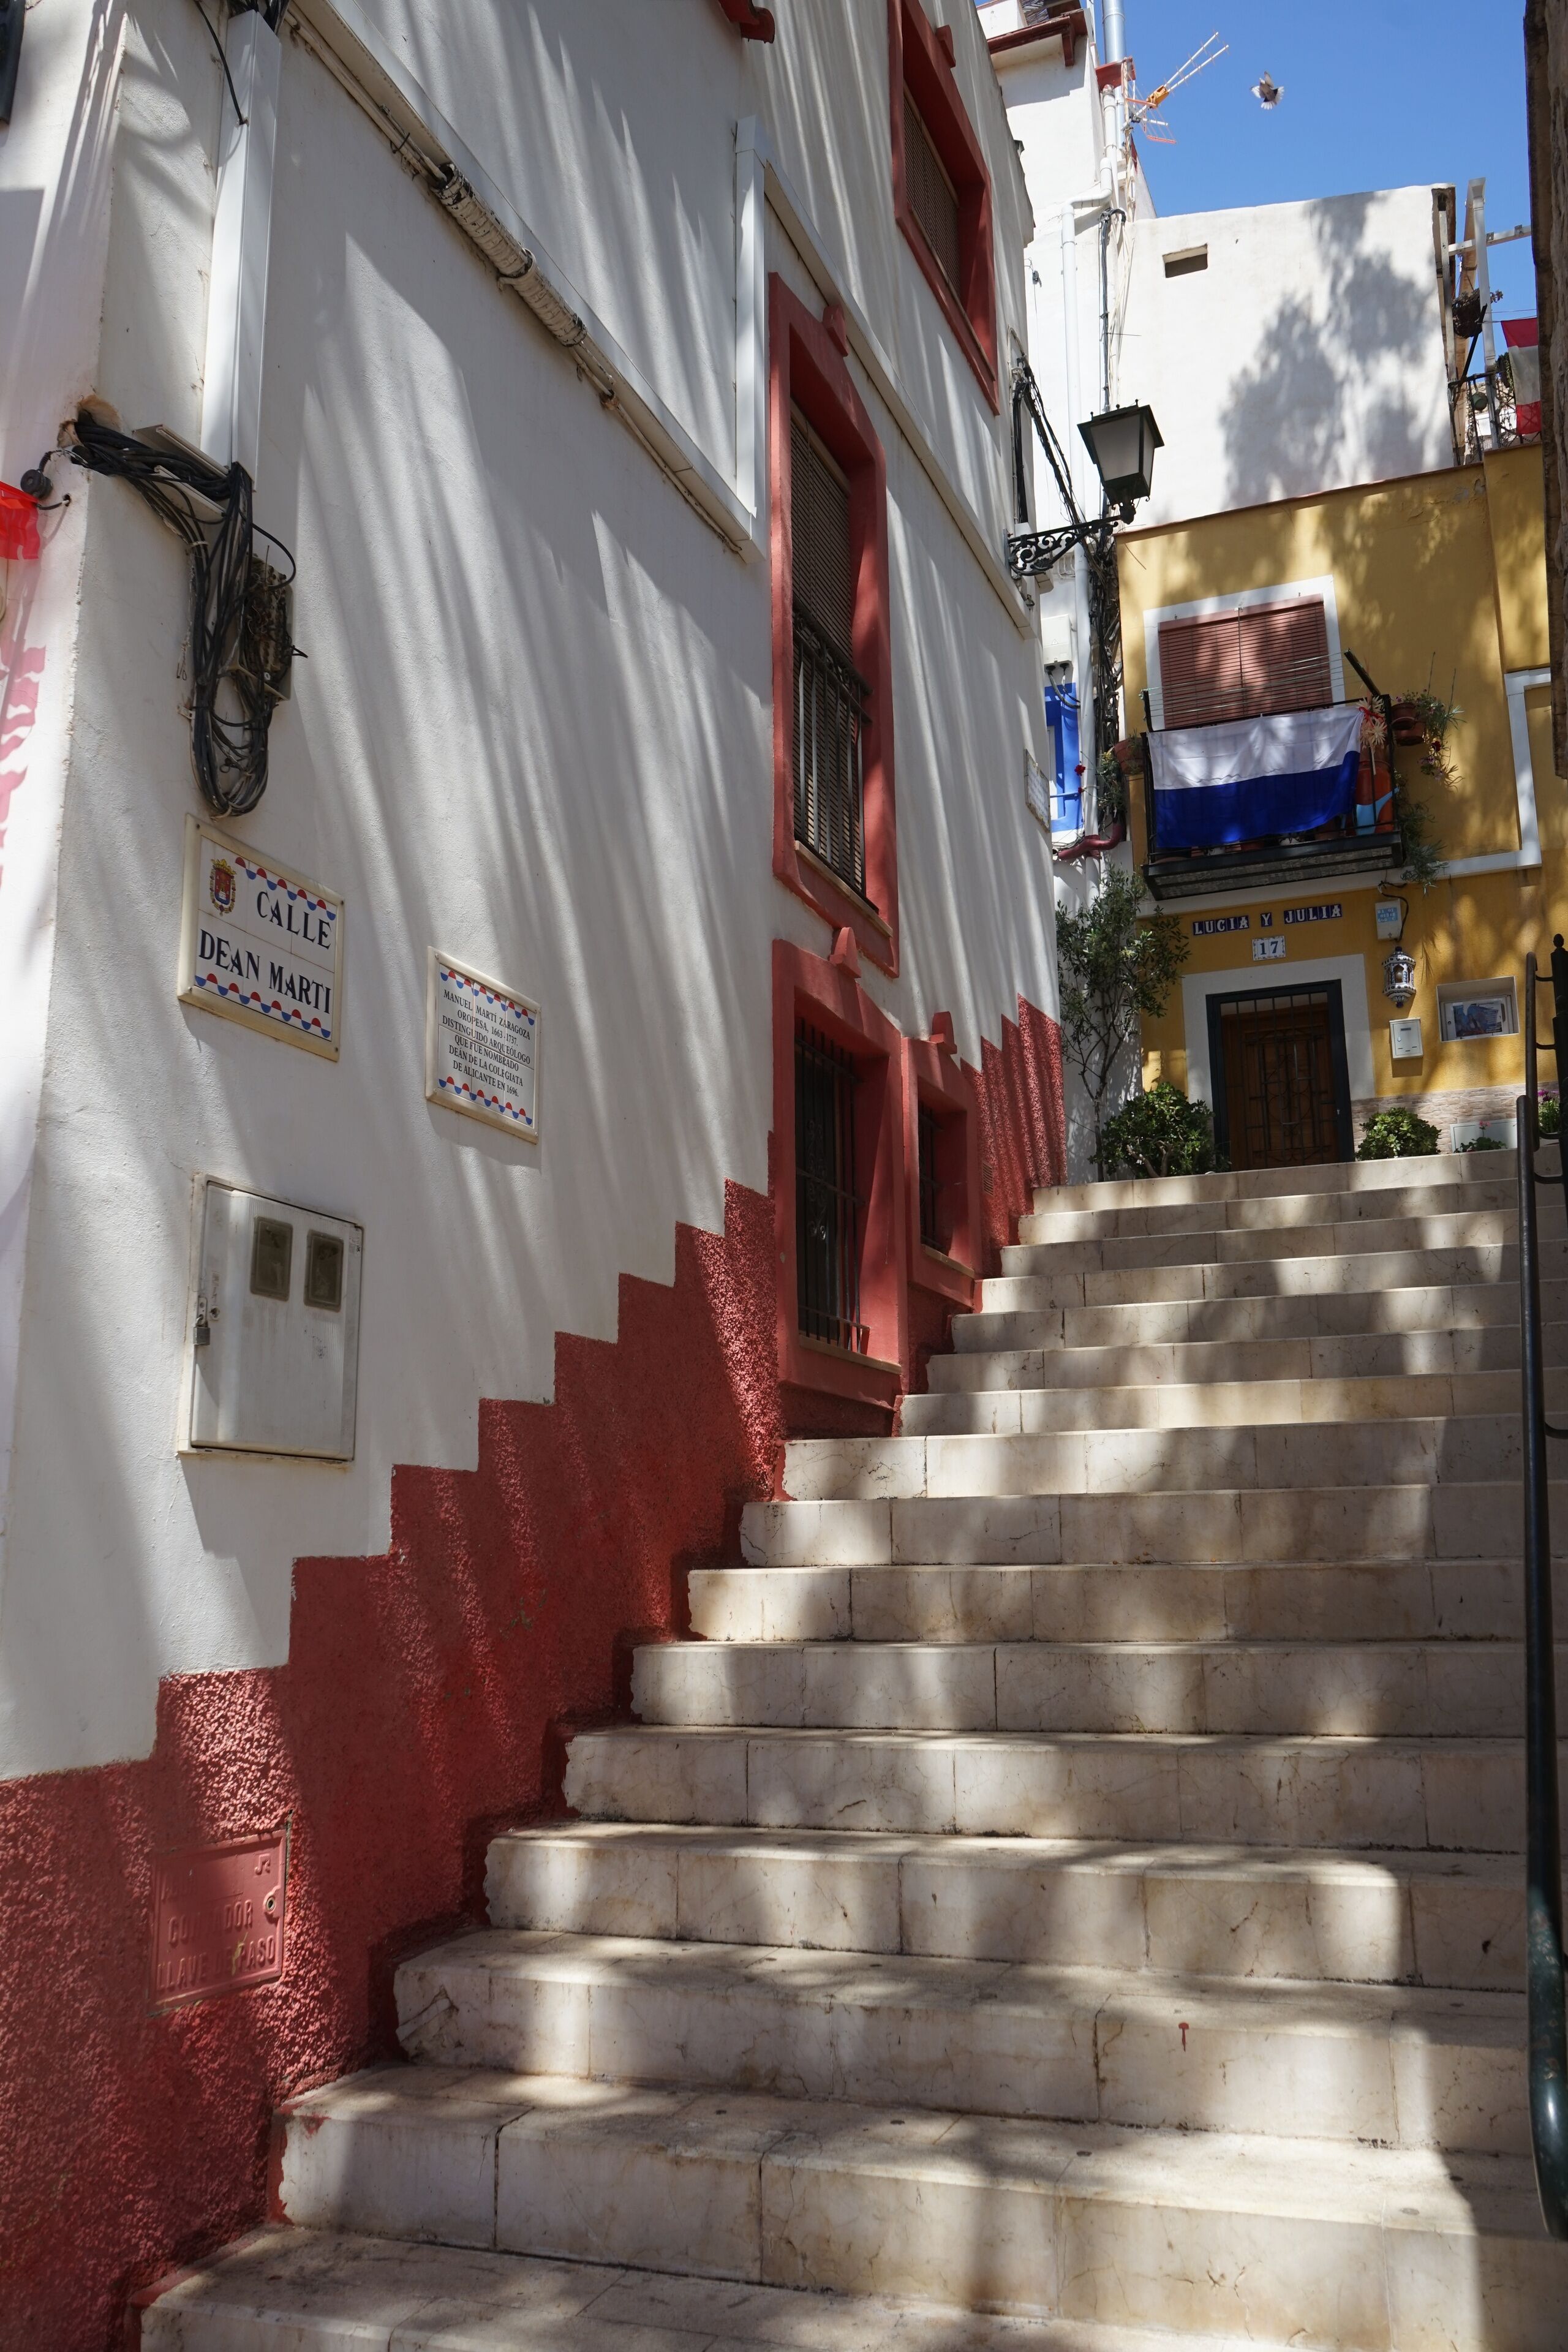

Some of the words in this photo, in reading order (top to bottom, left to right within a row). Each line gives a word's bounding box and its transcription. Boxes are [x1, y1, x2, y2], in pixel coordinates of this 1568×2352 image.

[257, 891, 331, 950] CALLE
[1195, 916, 1249, 935] LUCIA
[1262, 913, 1270, 925] Y
[1286, 905, 1341, 923] JULIA
[1260, 941, 1278, 956] 17
[198, 929, 260, 982] DEAN
[268, 961, 331, 1014] MARTI
[443, 989, 472, 1011] MANUEL
[476, 1005, 497, 1023] MARTÍ
[499, 1017, 530, 1040] ZARAGOZA
[458, 1009, 489, 1033] OROPESA,
[442, 1015, 488, 1044] DISTINGUIDO
[489, 1038, 530, 1065] ARQUEÓLOGO
[454, 1035, 469, 1048] QUE
[470, 1041, 482, 1055] FUE
[484, 1048, 519, 1071] NOMBRADO
[449, 1044, 467, 1060] DEÁN
[469, 1054, 478, 1066] DE
[479, 1058, 488, 1070] LA
[489, 1063, 523, 1087] COLEGIATA
[453, 1060, 462, 1071] DE
[464, 1065, 496, 1087] ALICANTE
[497, 1080, 505, 1091] EN
[507, 1085, 519, 1097] 1696.
[156, 1952, 208, 1990] LLAVE
[237, 1934, 276, 1969] PASO
